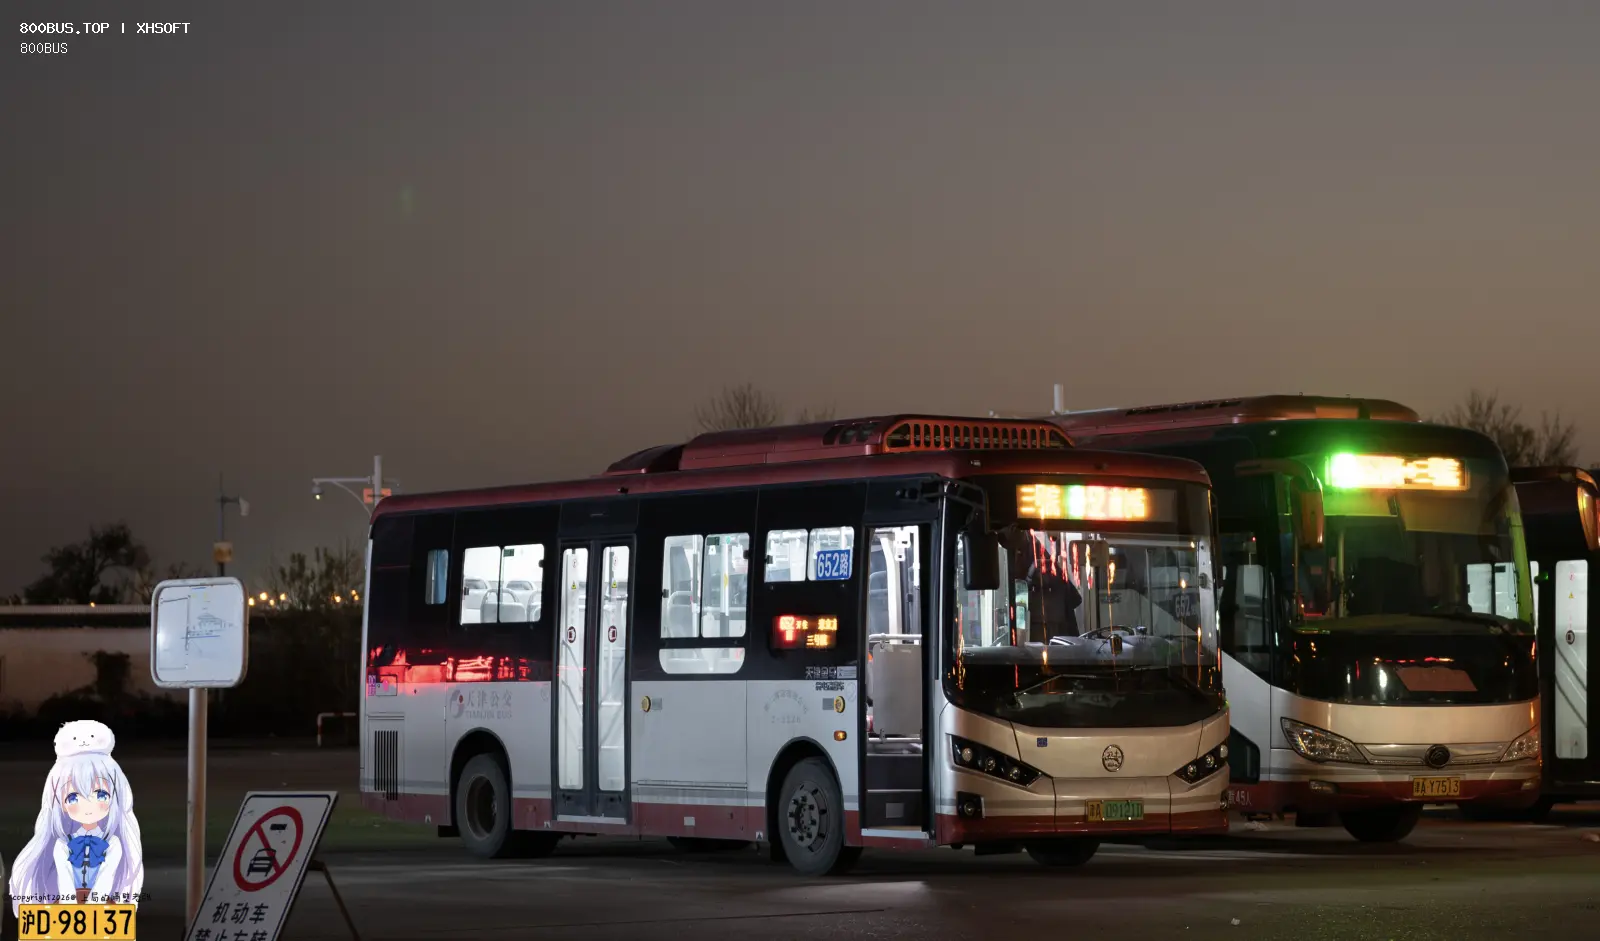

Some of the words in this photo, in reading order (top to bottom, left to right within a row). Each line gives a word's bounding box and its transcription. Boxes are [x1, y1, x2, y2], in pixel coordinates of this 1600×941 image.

[817, 552, 849, 580] 652路
[466, 689, 513, 708] 天津公交
[212, 902, 269, 925] 机动车
